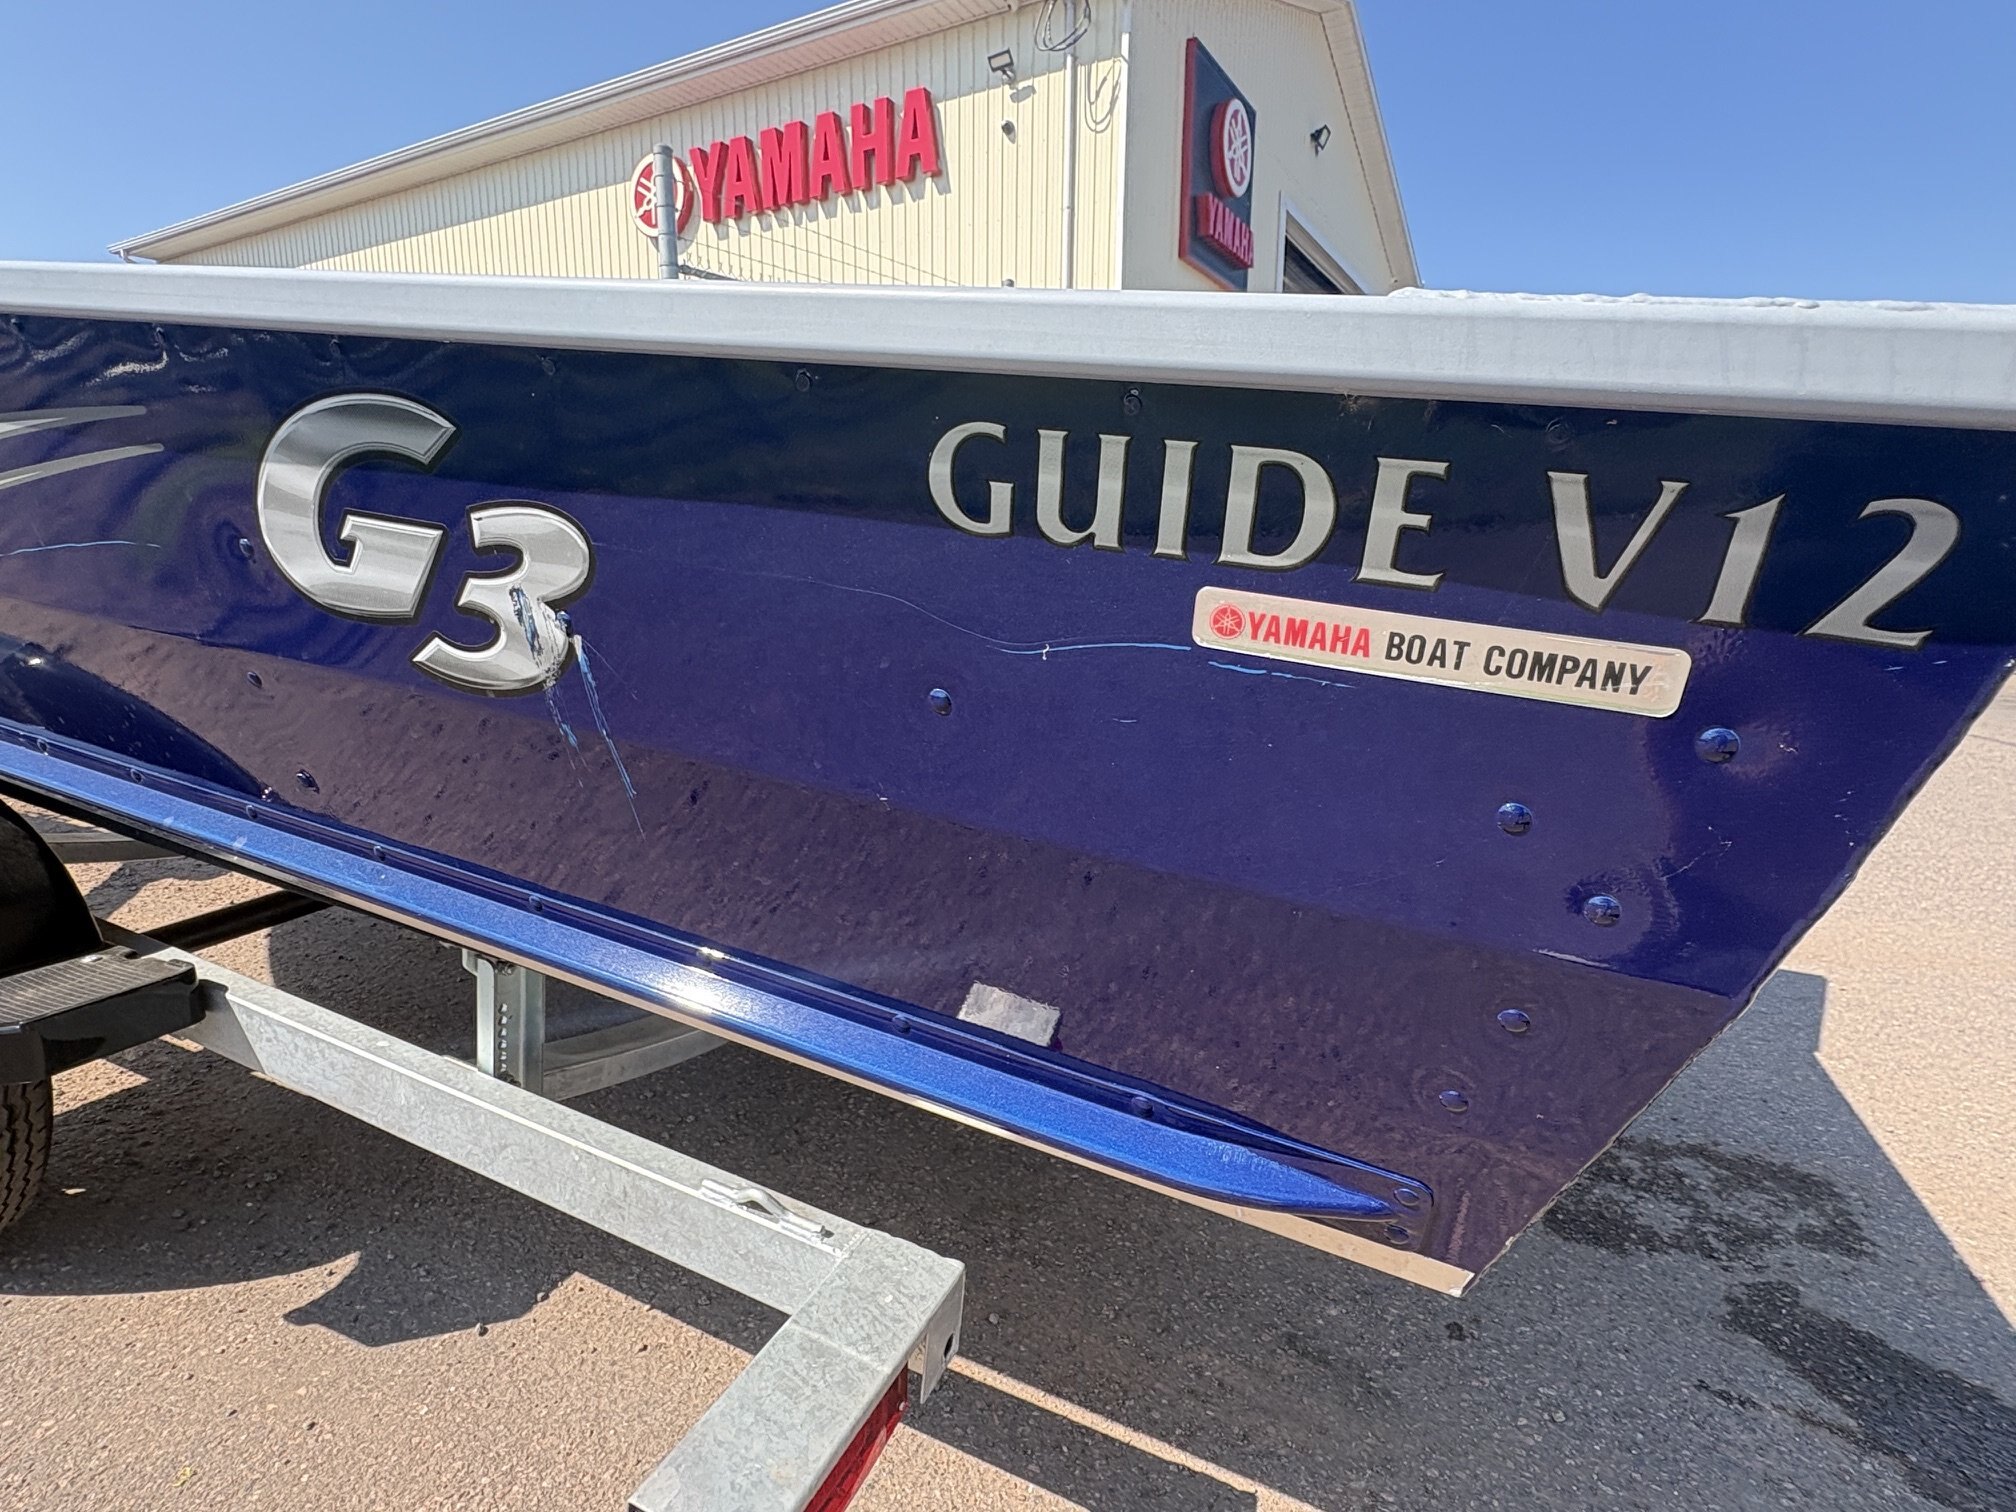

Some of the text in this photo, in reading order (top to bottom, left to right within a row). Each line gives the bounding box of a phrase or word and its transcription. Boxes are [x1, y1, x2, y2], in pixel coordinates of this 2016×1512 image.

[689, 86, 942, 223] YAMAHA
[256, 392, 592, 692] G3
[927, 420, 1962, 651] GUIDE V12
[1248, 611, 1653, 695] YAMAHA BOAT COMPANY
